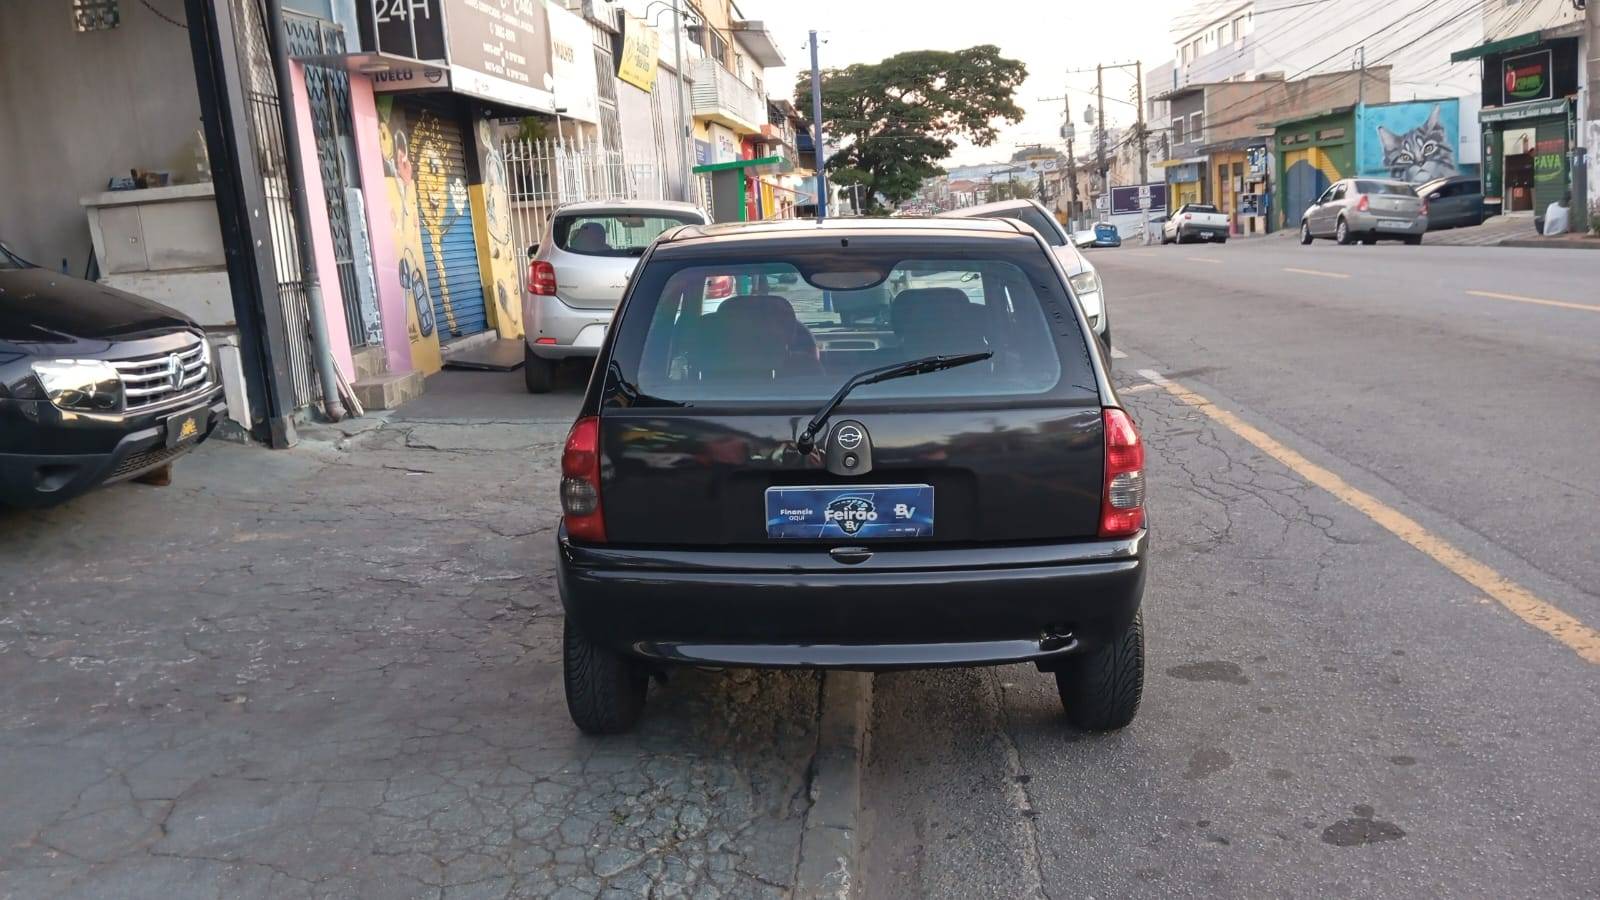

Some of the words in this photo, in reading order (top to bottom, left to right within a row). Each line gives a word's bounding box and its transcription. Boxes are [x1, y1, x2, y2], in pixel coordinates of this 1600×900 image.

[373, 0, 430, 23] 24H
[375, 68, 413, 82] IVECO
[824, 507, 878, 521] Feirão
[893, 503, 916, 519] BV
[845, 520, 859, 531] BV
